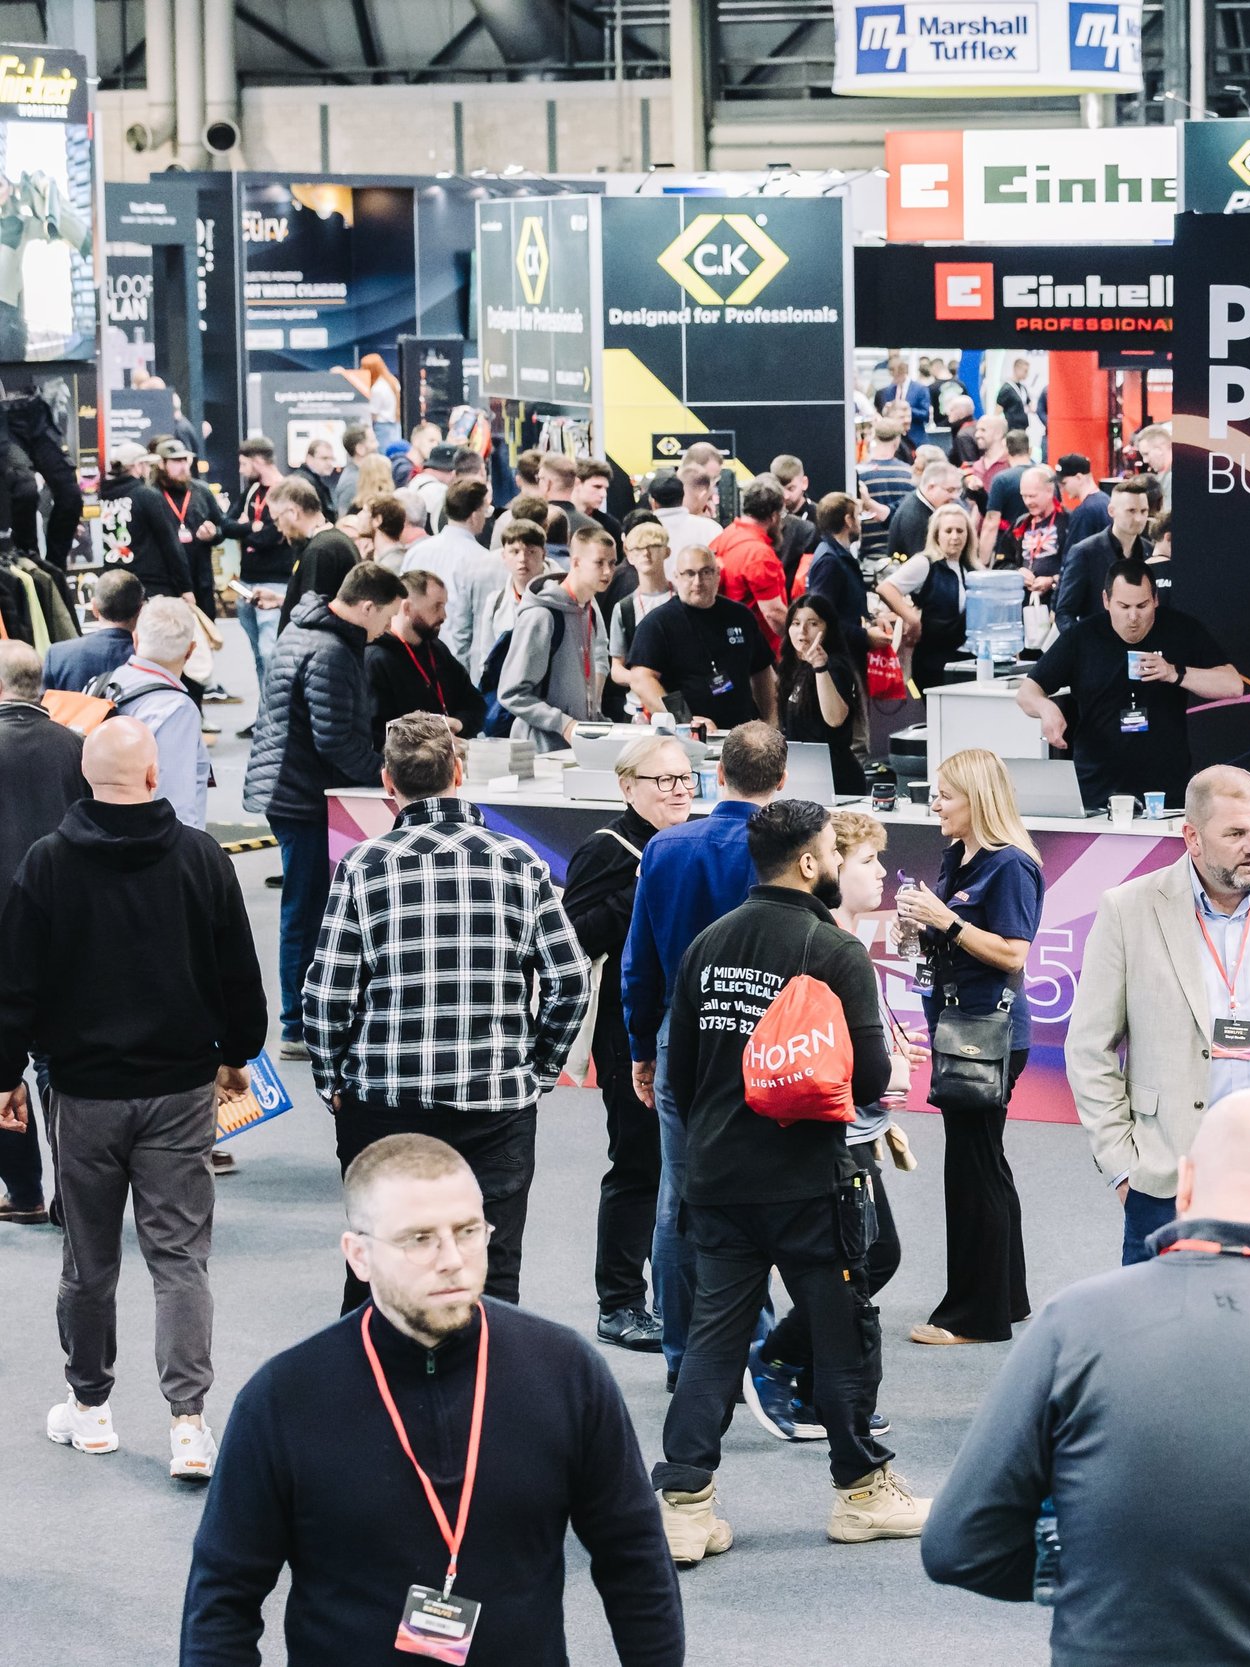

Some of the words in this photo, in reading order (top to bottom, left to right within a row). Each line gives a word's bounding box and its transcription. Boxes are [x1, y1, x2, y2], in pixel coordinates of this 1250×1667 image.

[919, 16, 1027, 35] Marshall
[930, 41, 1017, 60] Tufflex
[609, 307, 691, 328] Designed
[694, 308, 720, 324] for
[725, 306, 838, 325] Professionals
[720, 1002, 731, 1011] or
[751, 1067, 815, 1088] LIGHTING
